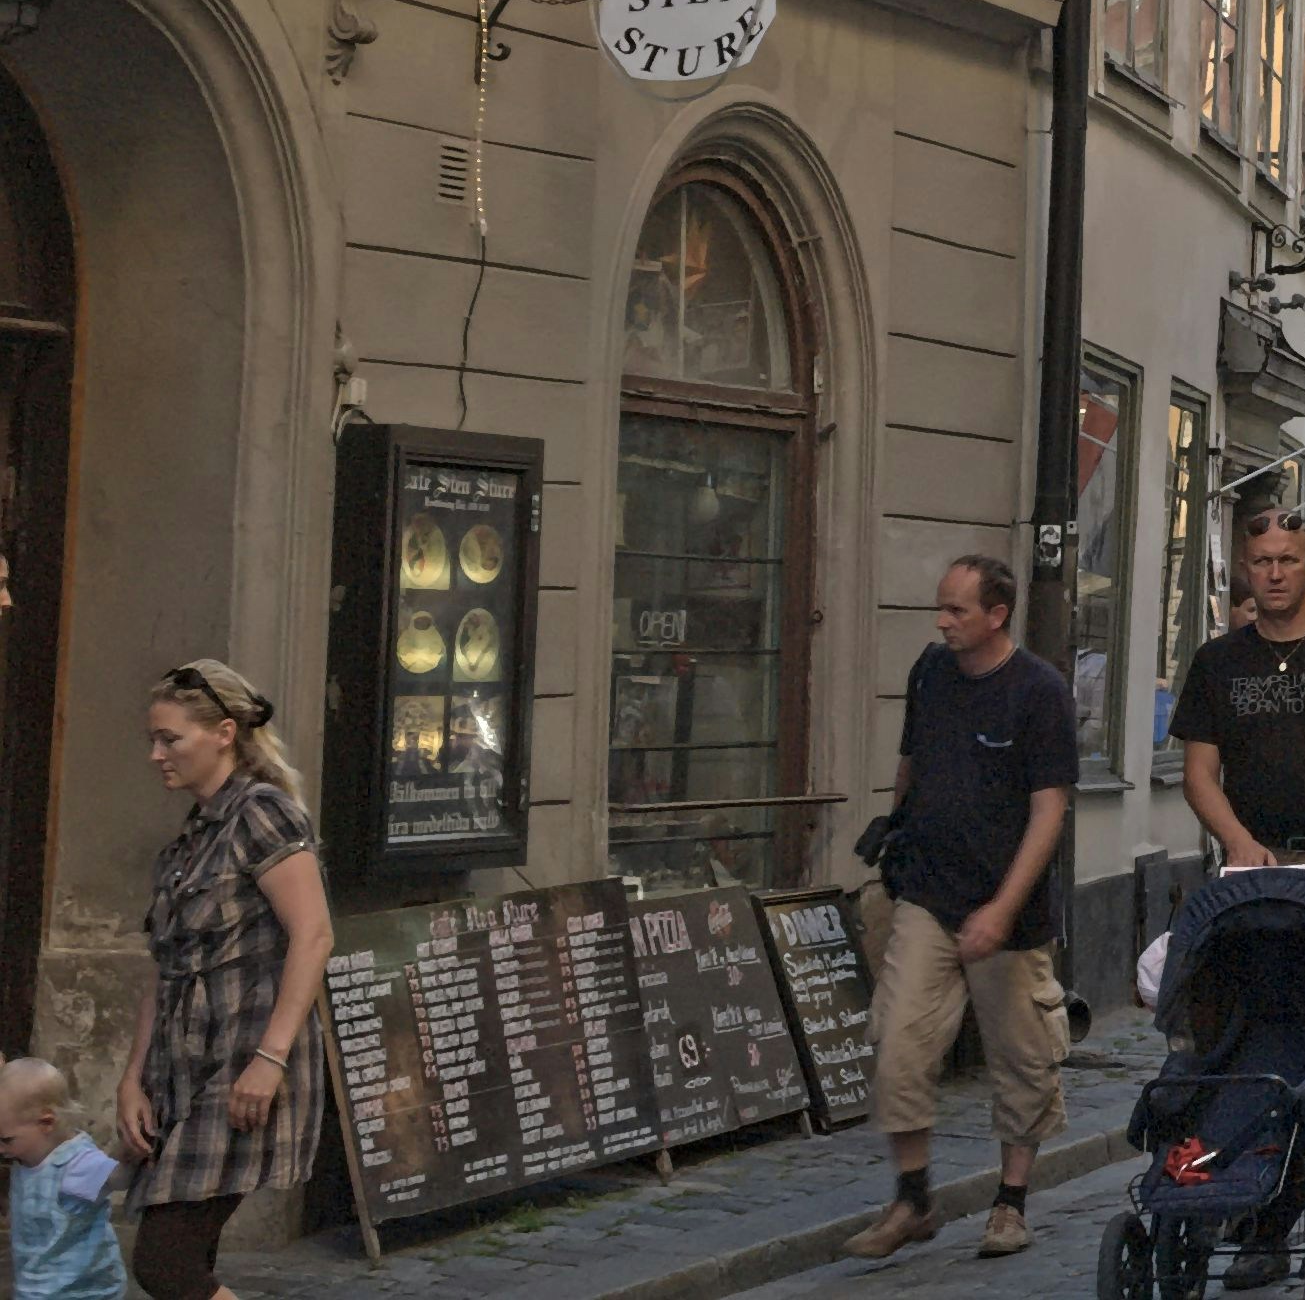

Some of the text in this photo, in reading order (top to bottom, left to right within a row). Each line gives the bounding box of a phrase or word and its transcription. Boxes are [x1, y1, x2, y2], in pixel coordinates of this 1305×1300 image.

[614, 6, 764, 77] STURE
[1231, 674, 1290, 693] TRAMPS
[1236, 699, 1281, 717] BORN
[1282, 698, 1304, 714] TO
[643, 910, 692, 956] PIZZA
[779, 904, 847, 947] DINNER
